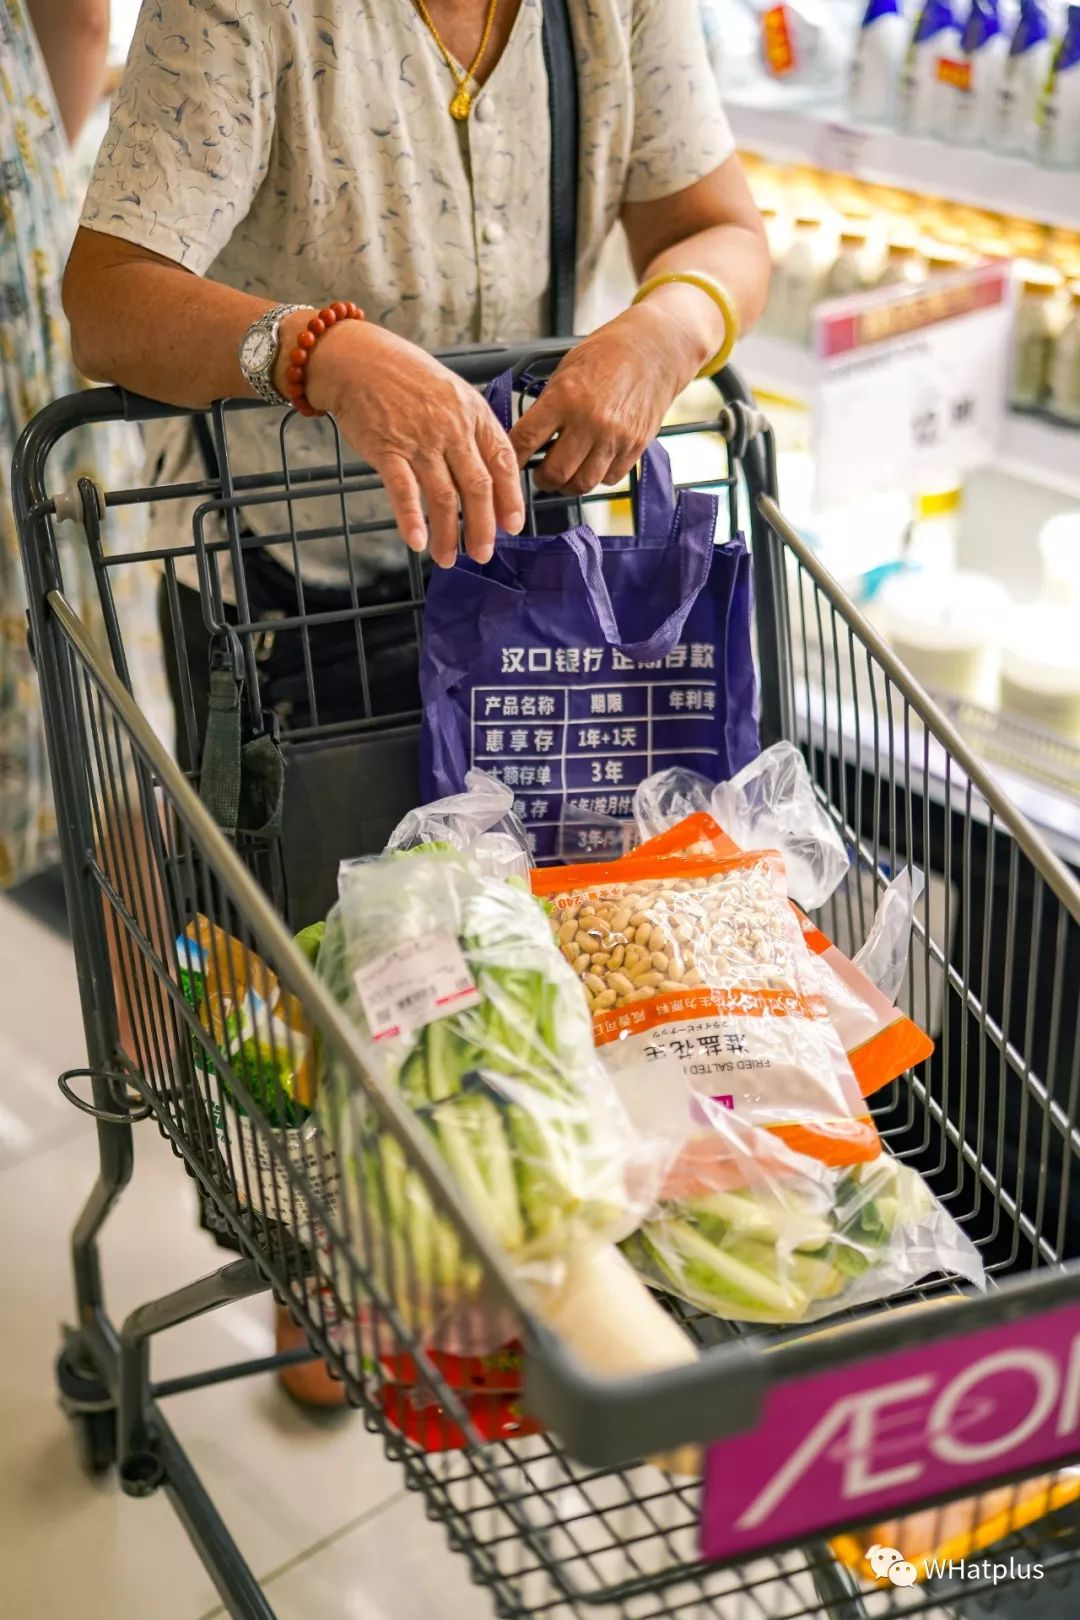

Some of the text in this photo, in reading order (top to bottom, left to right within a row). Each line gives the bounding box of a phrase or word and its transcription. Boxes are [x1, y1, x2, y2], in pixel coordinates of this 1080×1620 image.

[501, 647, 604, 673] 汉口银行
[484, 696, 555, 716] 产品名称
[590, 692, 624, 713] 期限
[669, 690, 716, 710] 年利率
[485, 729, 554, 752] 惠享存
[578, 727, 637, 748] 1年+1天
[591, 761, 624, 783] 3年
[690, 1062, 734, 1075] SALTED
[737, 1059, 771, 1072] FRIED
